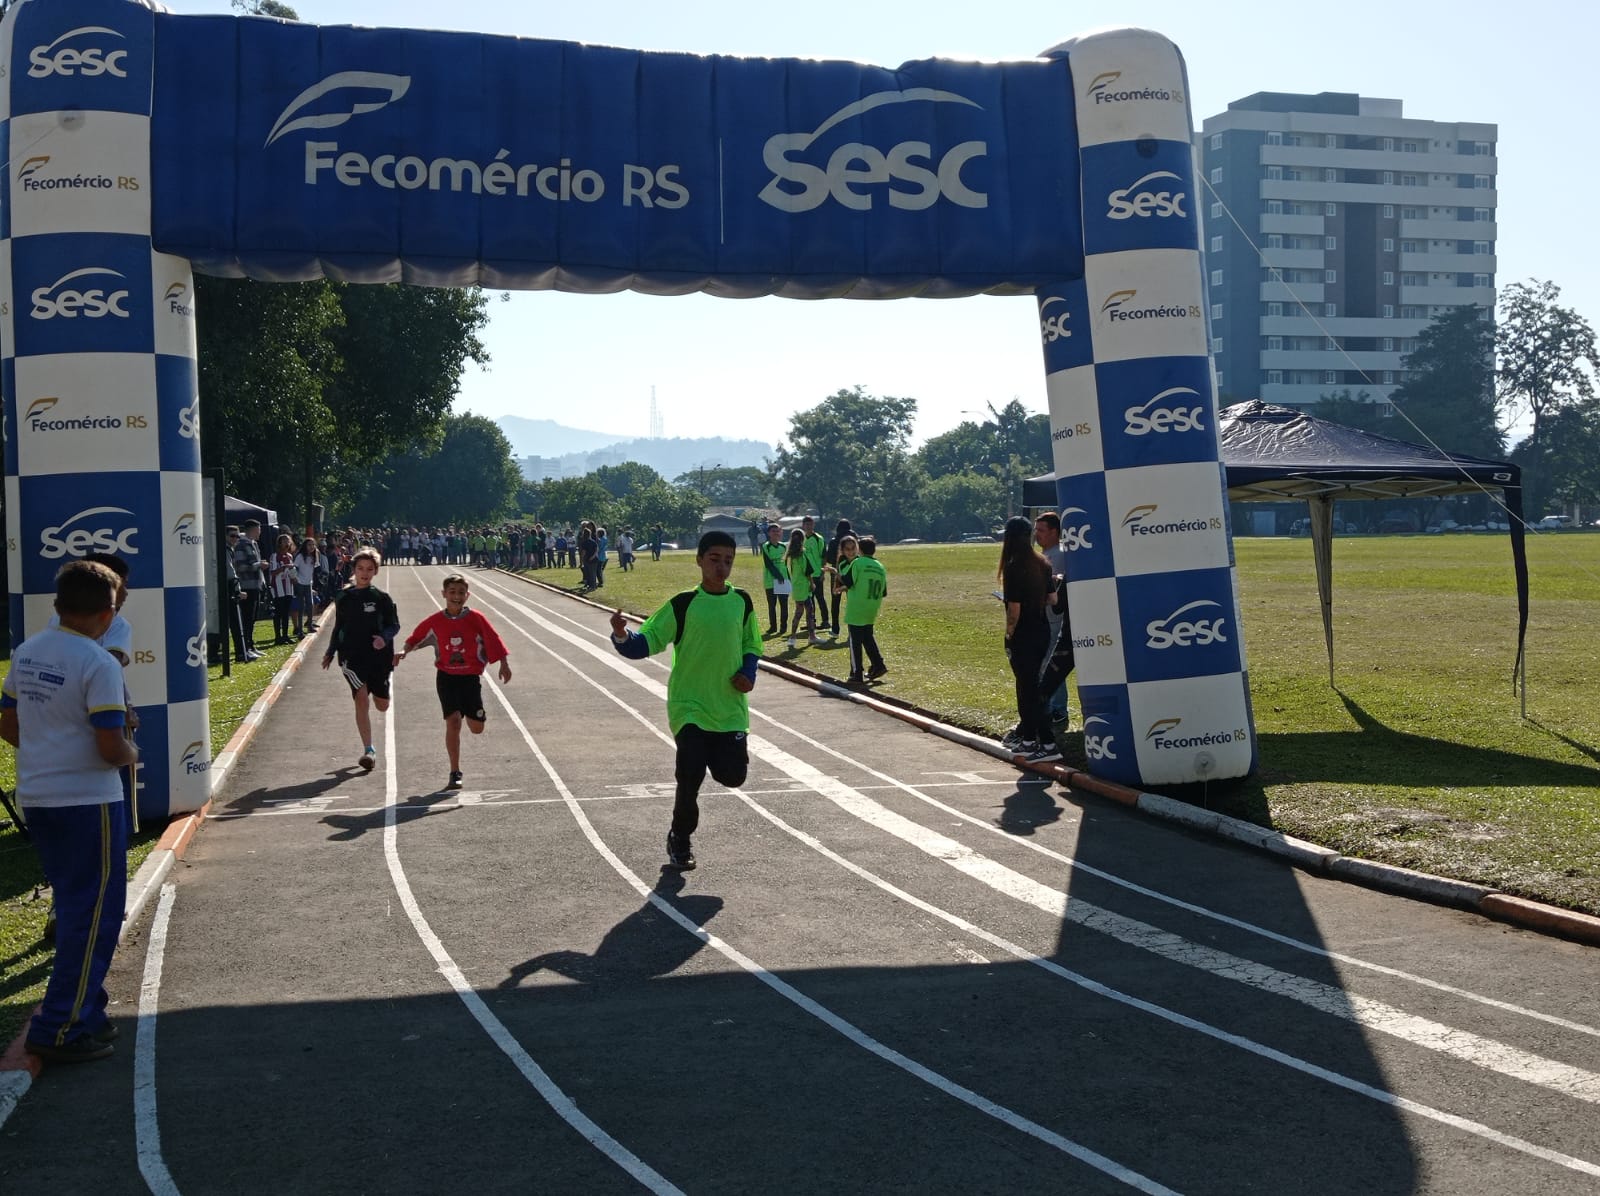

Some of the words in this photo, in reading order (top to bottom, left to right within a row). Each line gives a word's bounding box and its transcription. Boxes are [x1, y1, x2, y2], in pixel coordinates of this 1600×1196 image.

[1095, 88, 1169, 104] Fecomércio
[23, 173, 113, 192] Fecomércio
[118, 176, 140, 191] RS
[304, 140, 605, 202] Fecomércio
[622, 163, 690, 209] RS
[1109, 305, 1187, 322] Fecomércio
[1188, 305, 1201, 318] RS
[32, 415, 122, 433] Fecomércio
[126, 415, 148, 429] RS
[1075, 422, 1092, 437] RS
[1130, 518, 1208, 537] Fecomércio
[1209, 517, 1222, 530] RS
[868, 579, 881, 600] 10
[1096, 634, 1113, 647] RS
[134, 650, 156, 664] RS
[1154, 731, 1232, 750] Fecomércio
[1233, 728, 1247, 742] RS
